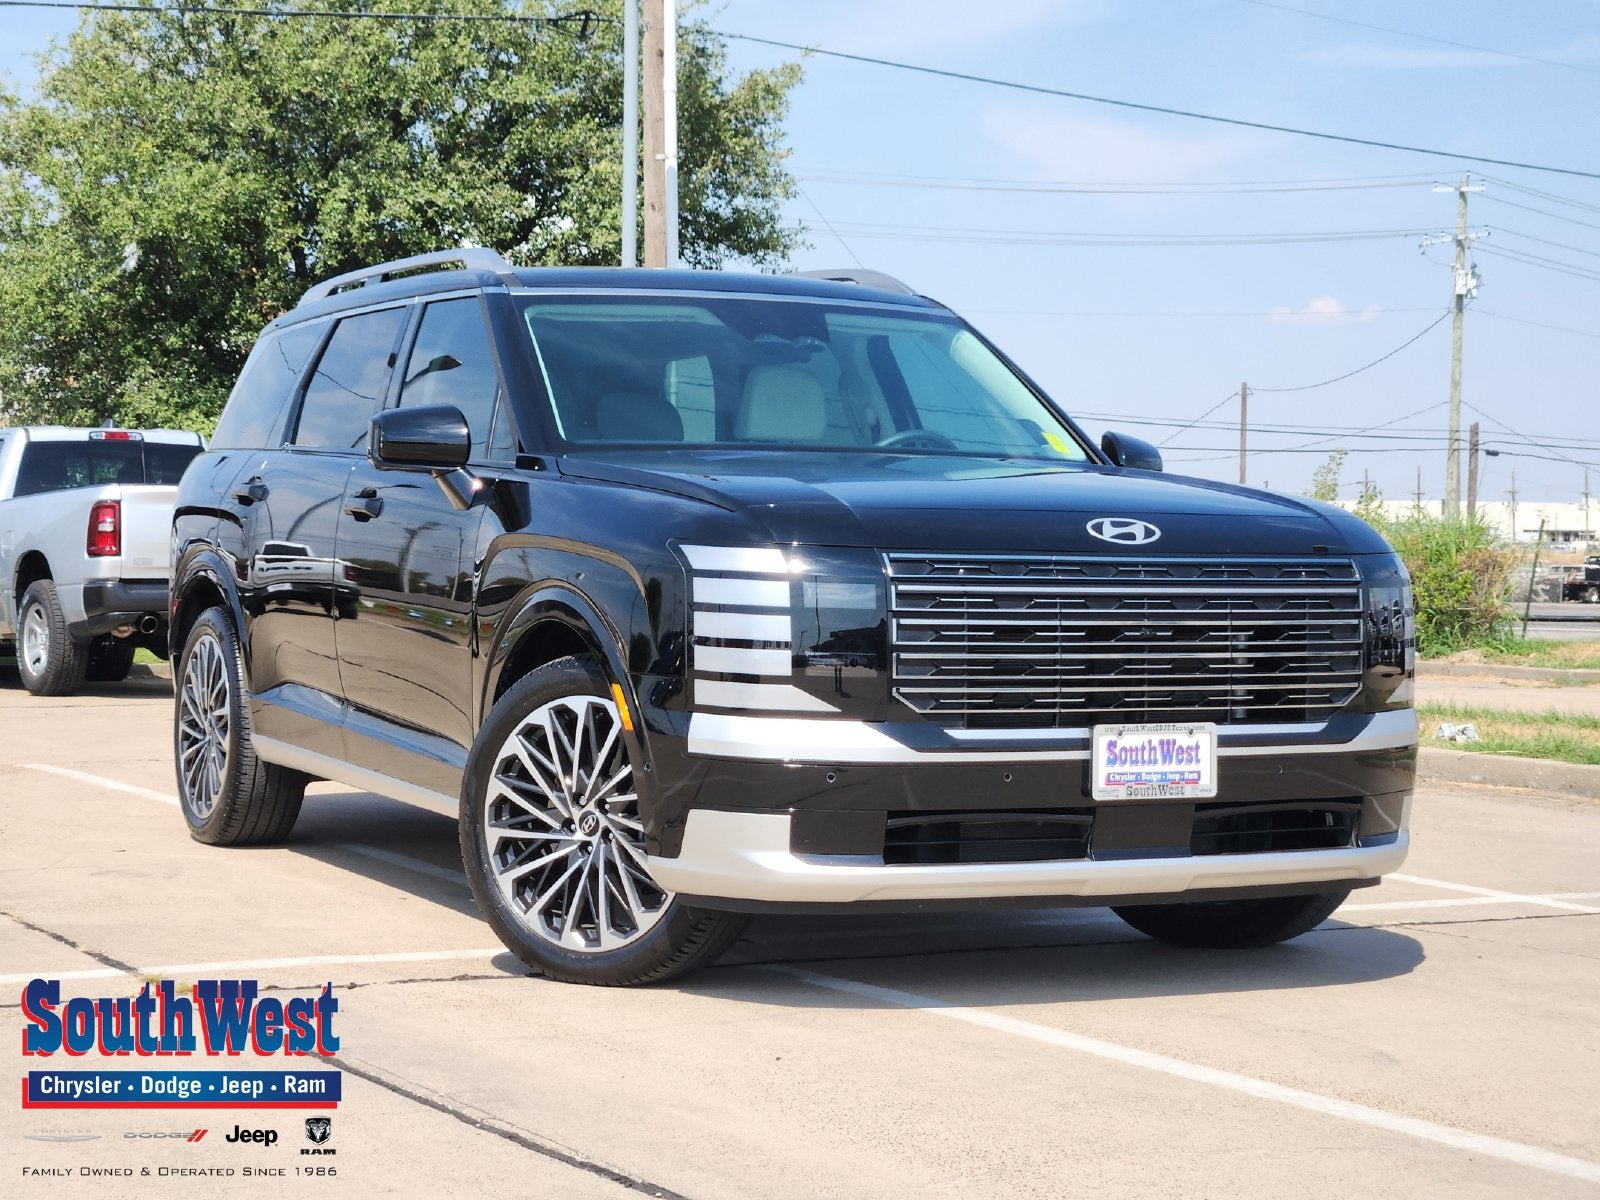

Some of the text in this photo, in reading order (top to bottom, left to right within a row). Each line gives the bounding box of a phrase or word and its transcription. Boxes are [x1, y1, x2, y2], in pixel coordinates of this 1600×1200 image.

[1105, 738, 1201, 767] SouthWest
[1110, 773, 1136, 782] Chrysler
[1141, 772, 1161, 782] Dodge
[1166, 772, 1181, 781] Jeep
[1126, 785, 1185, 797] SouthWest
